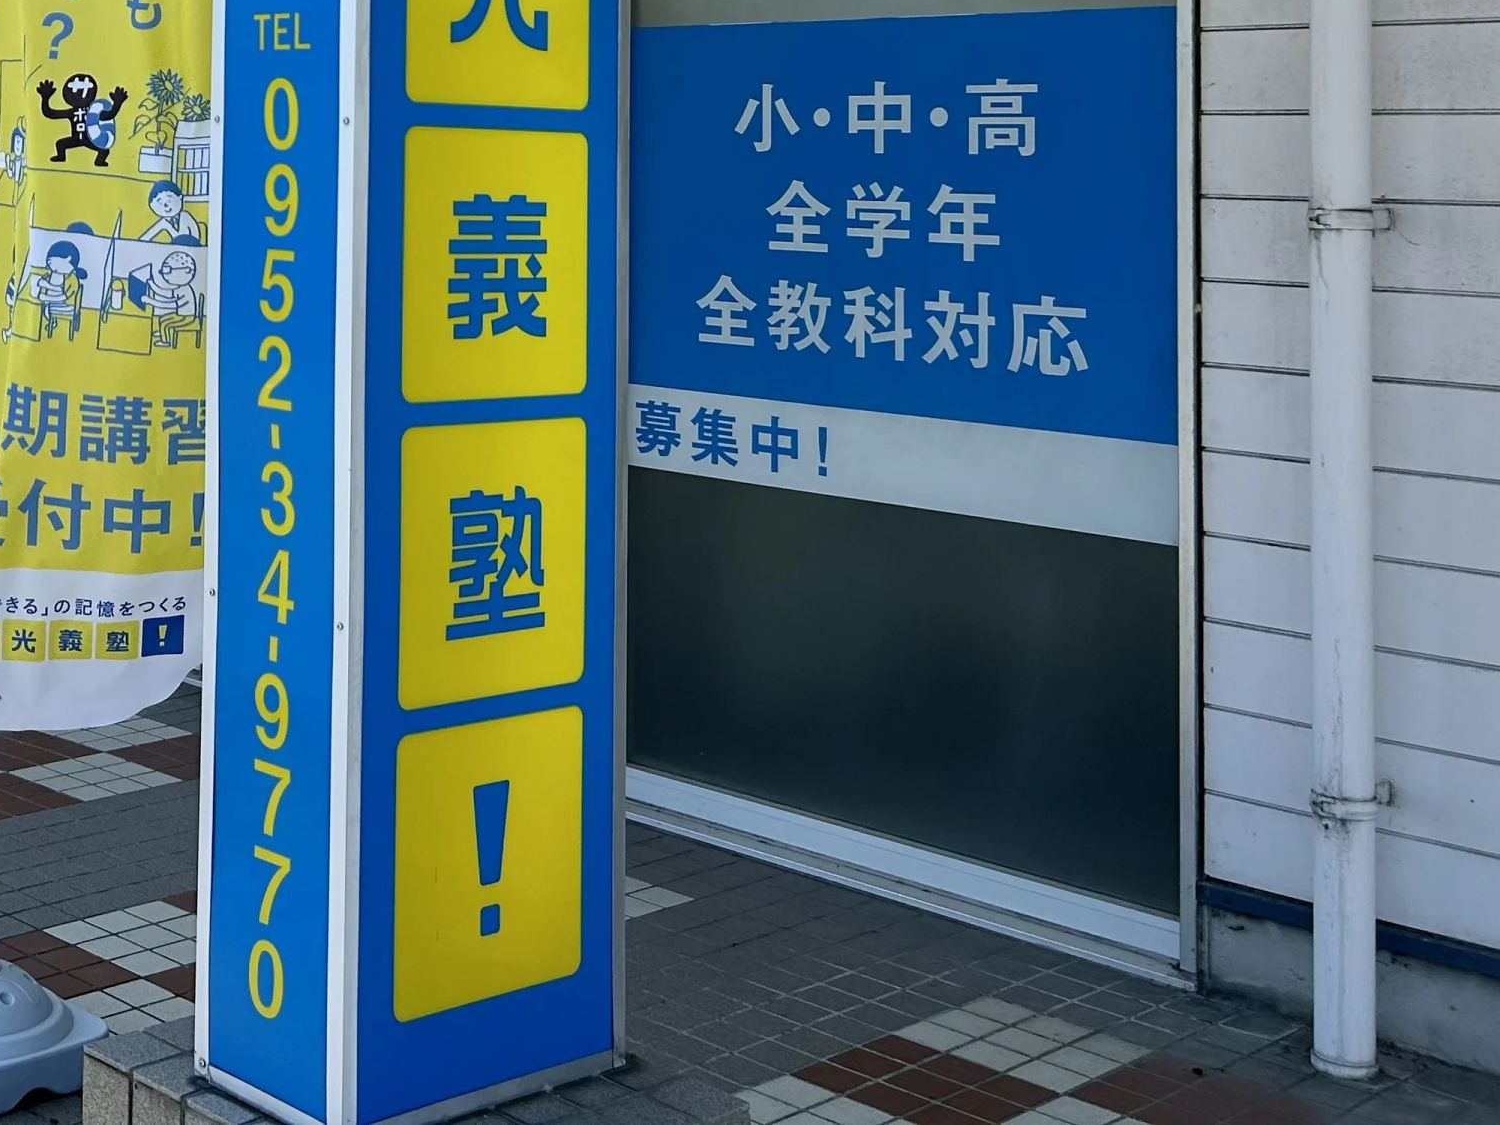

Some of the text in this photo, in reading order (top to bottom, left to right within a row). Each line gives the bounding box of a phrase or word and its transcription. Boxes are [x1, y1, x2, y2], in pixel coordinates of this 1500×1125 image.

[252, 11, 312, 52] TEL
[765, 179, 1001, 263] 全学年
[695, 274, 1089, 377] 全教科対応
[634, 399, 829, 477] 募集中!
[247, 77, 301, 1020] 0952-34-9770
